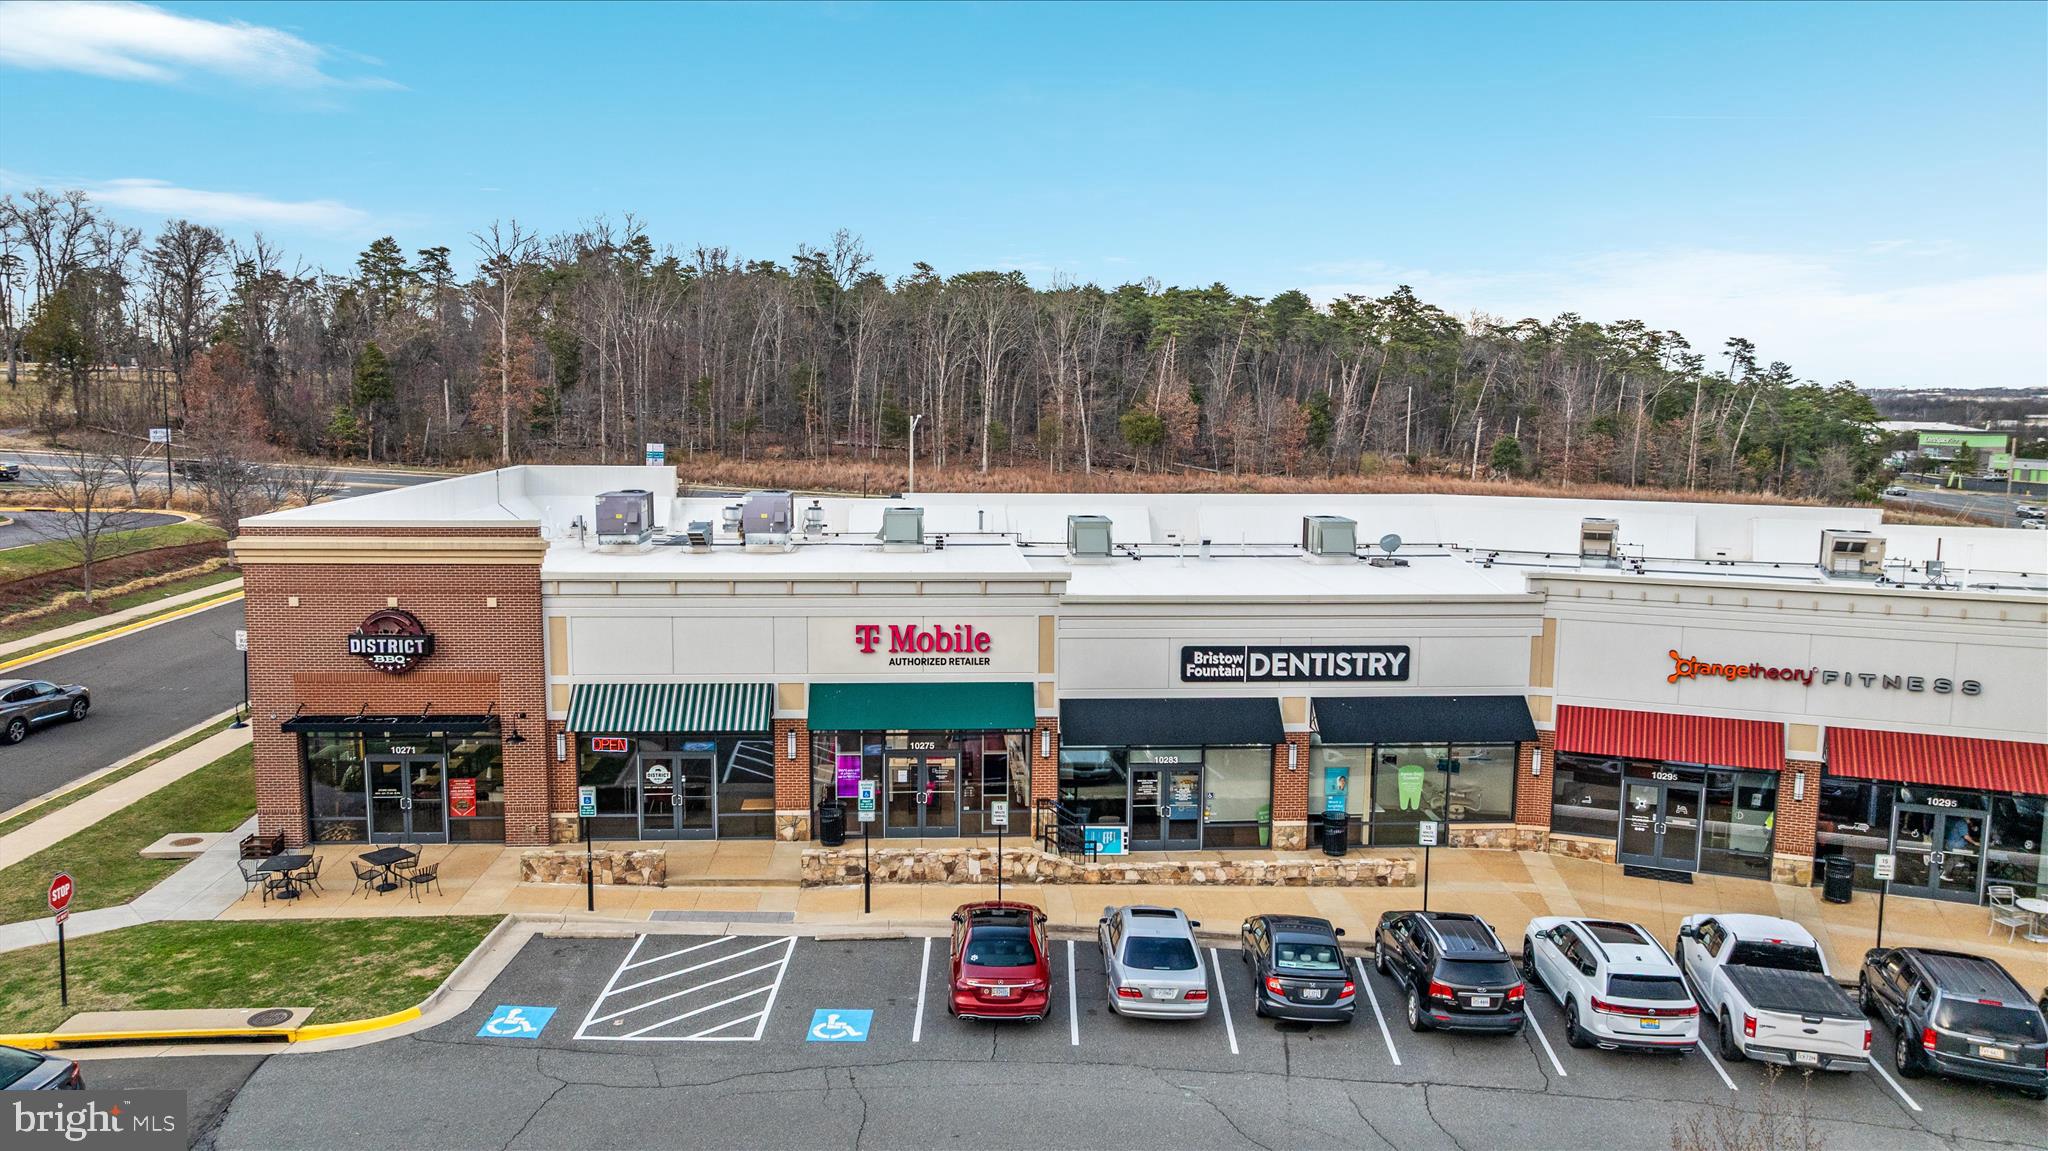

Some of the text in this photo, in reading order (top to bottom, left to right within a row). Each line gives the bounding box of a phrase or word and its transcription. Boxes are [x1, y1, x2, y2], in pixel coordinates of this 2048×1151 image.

[855, 623, 991, 654] T Mobile
[350, 638, 425, 654] DISTRICT
[888, 657, 991, 666] AUTHORIZED RETAILER
[1194, 651, 1244, 665] Bristow
[1250, 652, 1407, 677] DENTISTRY
[1186, 664, 1244, 677] Fountain
[1822, 669, 1982, 696] FITNESS
[390, 746, 416, 754] 10271
[593, 738, 627, 751] OPEN
[910, 741, 935, 750] 10275
[1154, 756, 1179, 764] 10283
[1651, 771, 1678, 781] 10295
[1926, 797, 1957, 807] 10295
[52, 883, 70, 902] STOP
